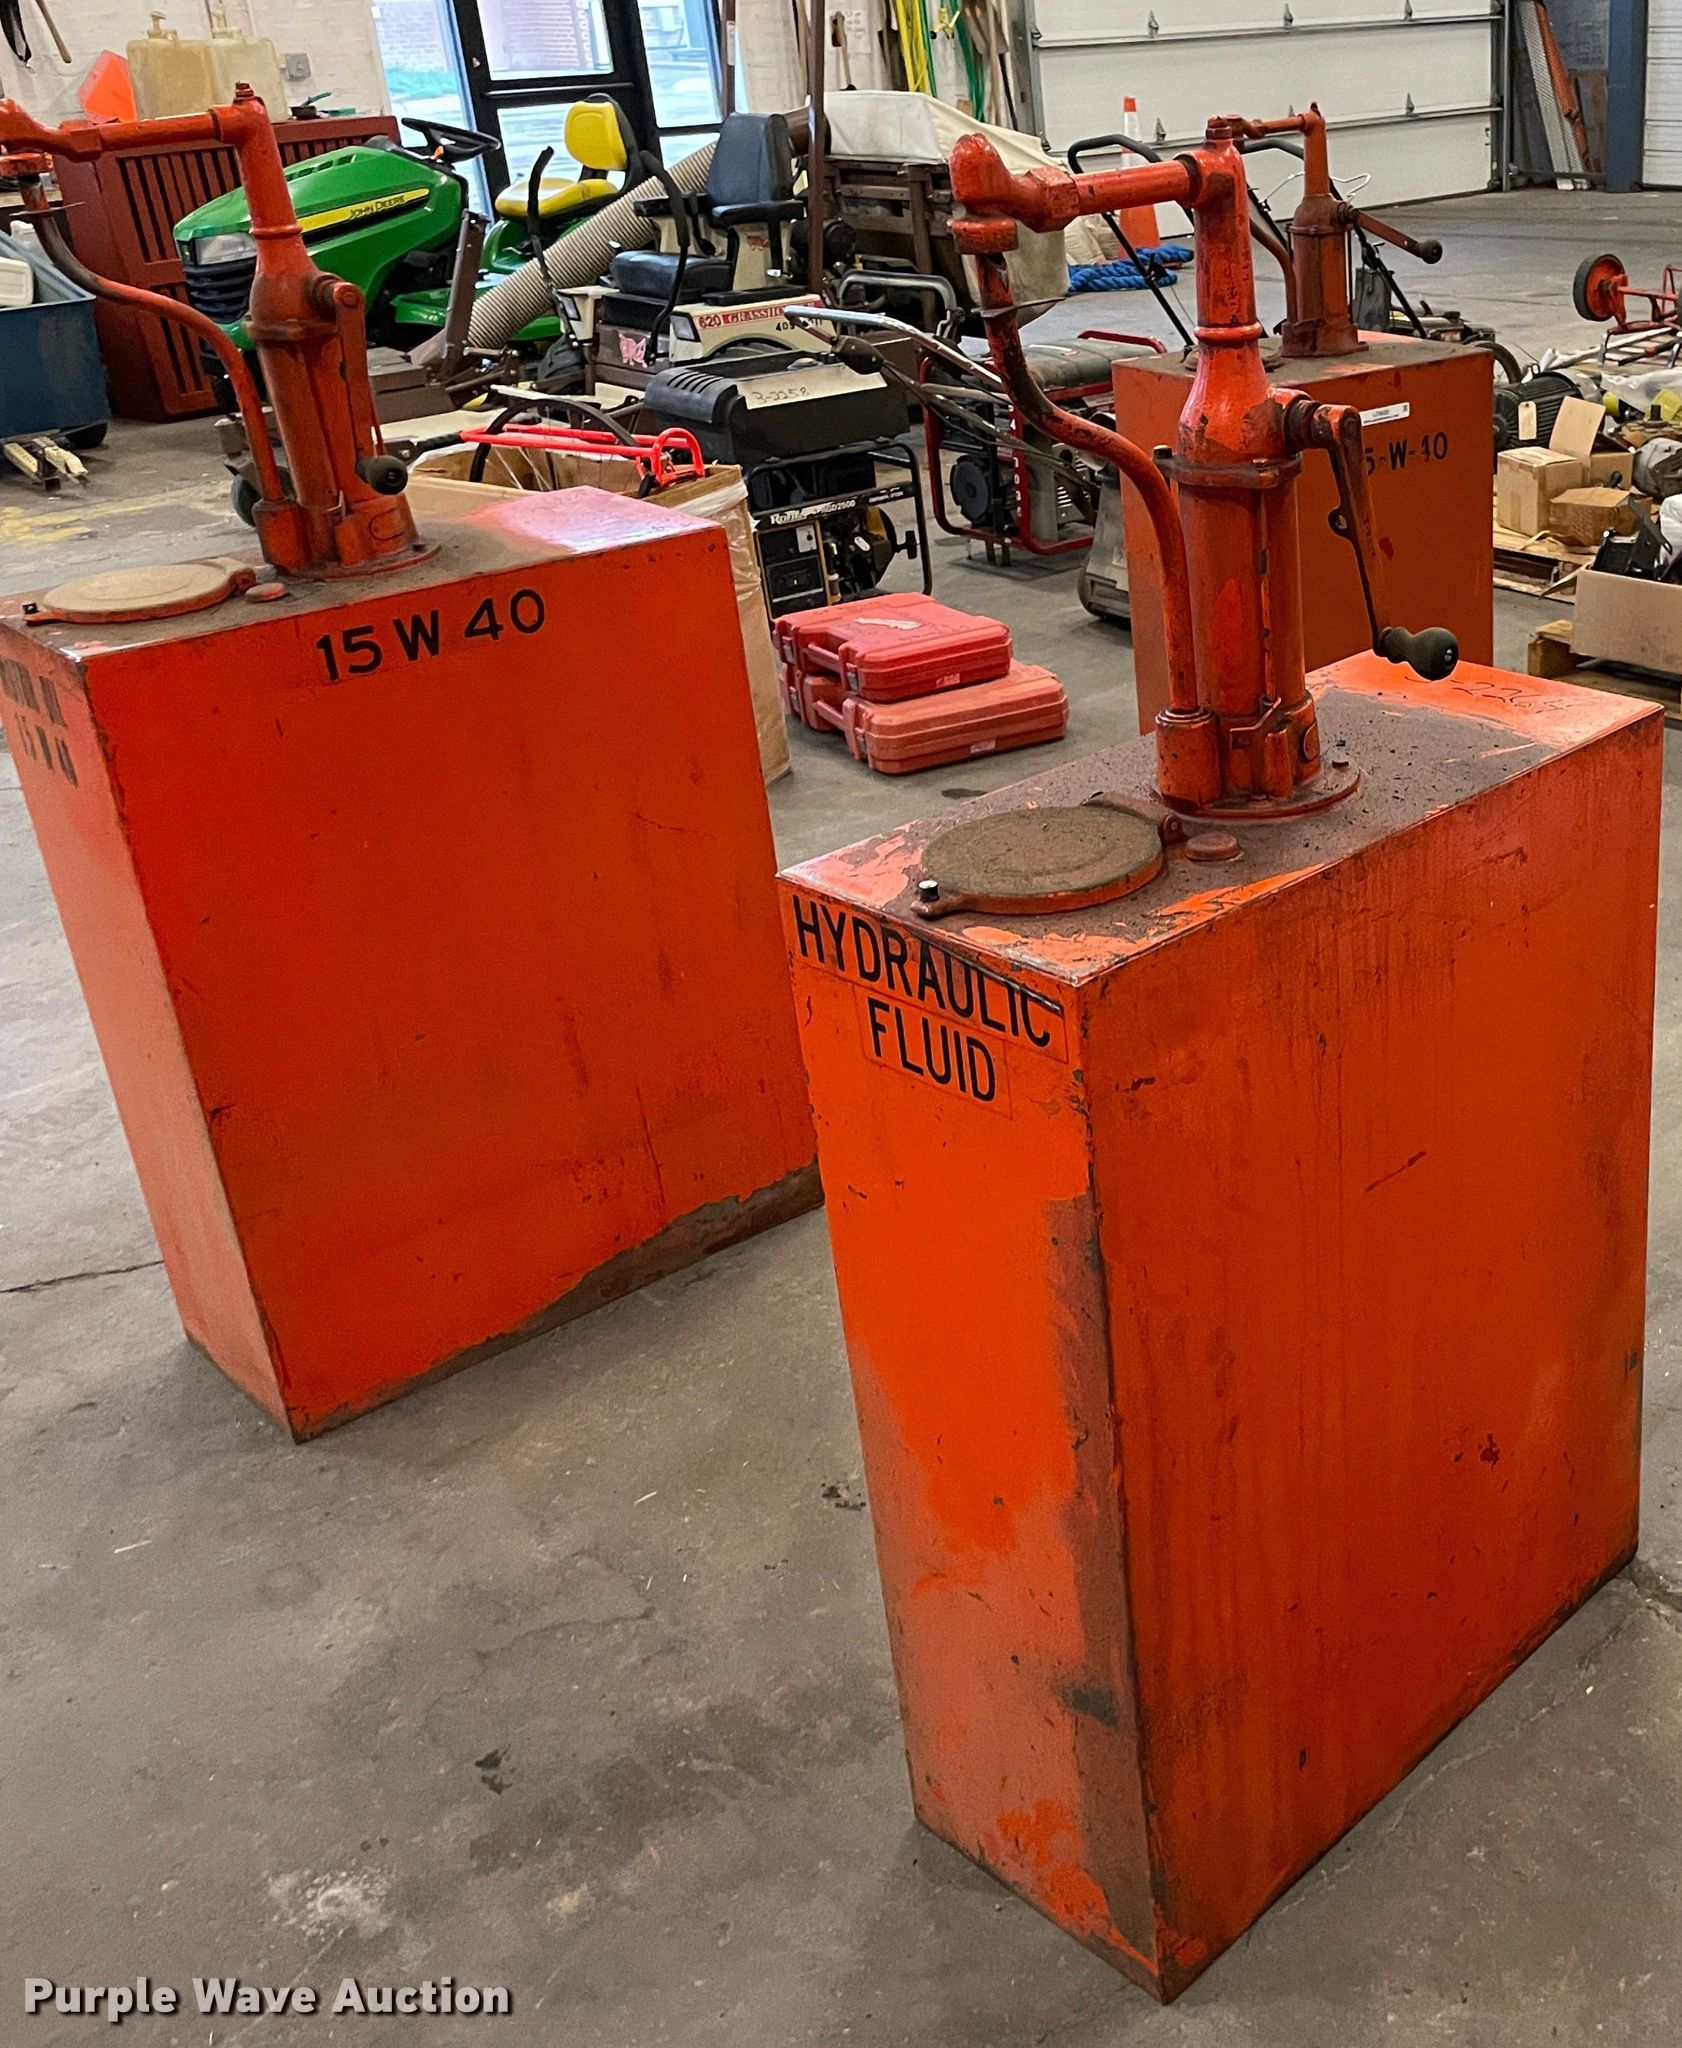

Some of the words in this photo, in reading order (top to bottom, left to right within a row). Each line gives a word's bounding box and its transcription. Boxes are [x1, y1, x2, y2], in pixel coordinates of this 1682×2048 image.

[350, 205, 375, 219] JOHN
[375, 195, 405, 211] DEERE
[699, 314, 722, 330] 620
[316, 624, 383, 683] 15
[392, 609, 440, 662] W
[464, 588, 545, 641] 40
[792, 895, 1050, 1048] HYDRAULIC
[867, 996, 996, 1102] FLUID
